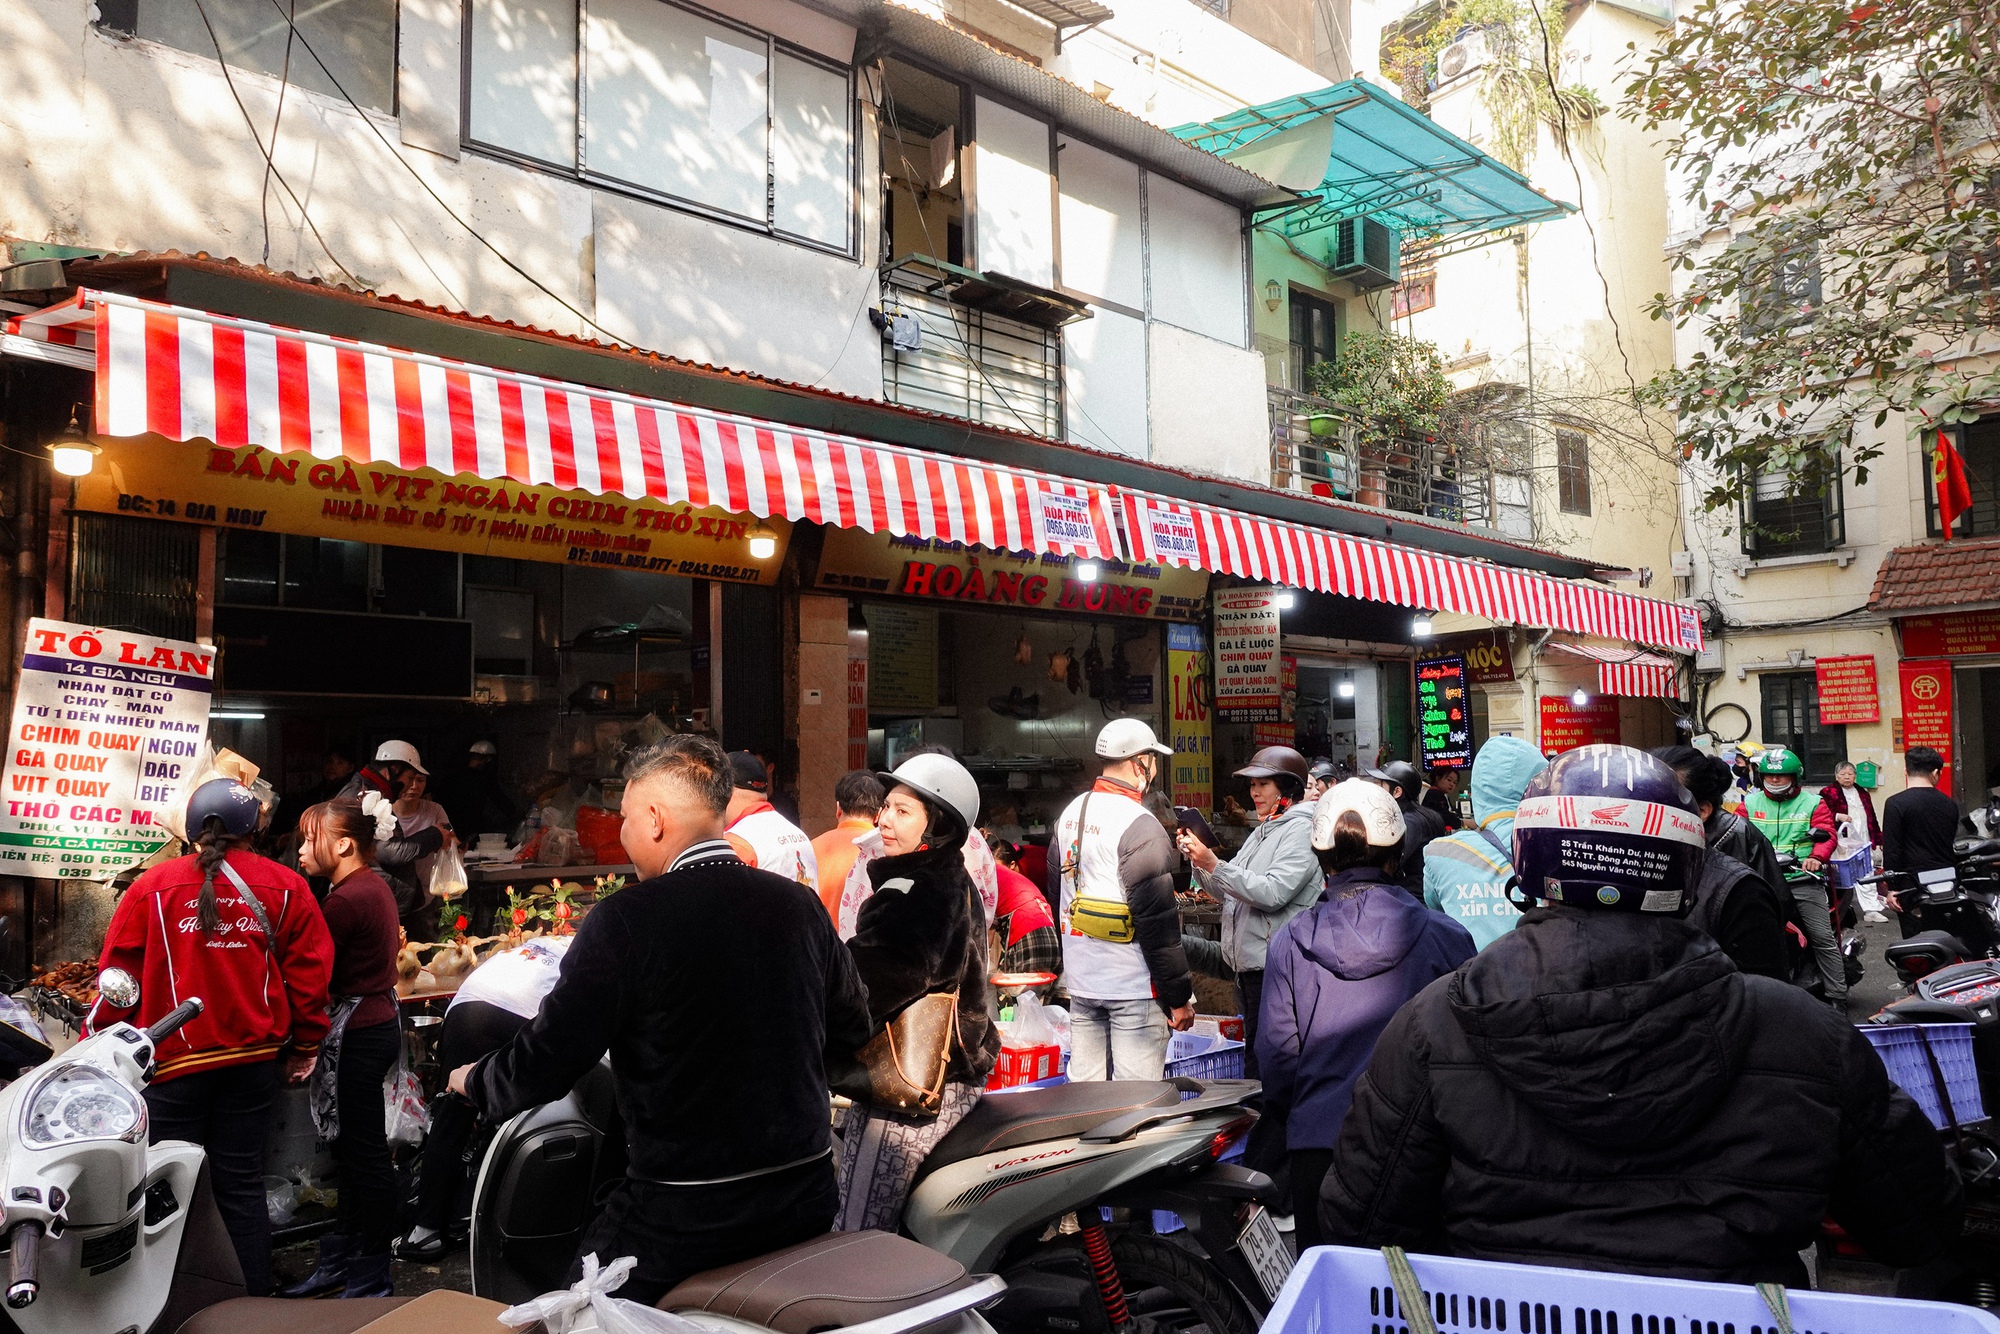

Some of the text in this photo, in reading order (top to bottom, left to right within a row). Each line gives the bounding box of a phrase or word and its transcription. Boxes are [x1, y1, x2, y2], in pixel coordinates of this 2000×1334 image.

[208, 447, 749, 542] BÁN GÀ VỊT NGAN CHIM THỎ XỊN
[156, 498, 175, 516] 14
[185, 502, 216, 522] GIA
[1046, 518, 1094, 540] 0966.868.491
[903, 556, 1153, 616] HOÀNG DUNG
[1217, 592, 1227, 600] GÀ
[1228, 590, 1253, 600] HOÀNG
[1217, 612, 1248, 622] NHẬN
[1945, 625, 1977, 635] QUẢN LÝ
[1219, 639, 1232, 650] GÀ
[1249, 638, 1274, 650] LUỘC
[1946, 634, 1967, 645] QUẢN
[1969, 634, 1978, 643] LÝ
[35, 629, 211, 676] TỐ LAN
[1220, 652, 1273, 663] CHIM QUAY
[1466, 641, 1503, 674] MỘC
[1947, 645, 1987, 655] ĐỊA CHÍNH
[65, 661, 177, 686] 14 GIA NGƯ
[1227, 663, 1267, 674] GÀ QUAY
[57, 679, 105, 695] NHẬN
[112, 685, 146, 701] ĐẶT
[1218, 675, 1277, 688] VỊT QUAY LẠNG SƠN
[1420, 680, 1435, 693] Gà
[1219, 687, 1233, 695] XÔI
[1234, 686, 1250, 695] CÁC
[63, 694, 109, 709] CHAY
[1558, 702, 1570, 713] GÀ
[26, 705, 200, 734] TỪ 1 ĐẾN NHIỀU MÂM
[1231, 715, 1248, 723] 0912
[1249, 708, 1268, 716] 5555
[20, 724, 141, 752] CHIM QUAY
[1200, 735, 1211, 757] VỊT
[148, 737, 197, 757] NGON
[16, 748, 109, 774] GÀ QUAY
[144, 761, 181, 782] ĐẶC
[12, 774, 110, 799] VỊT QUAY
[8, 799, 59, 819] THỎ
[70, 804, 122, 824] CÁC
[1590, 818, 1630, 828] HONDA
[73, 825, 94, 836] VỤ
[103, 827, 129, 839] TẠI
[134, 829, 167, 839] NHÀ
[32, 836, 152, 852] GIÁ CẢ HỢP LÝ
[1561, 839, 1671, 862] 25 Trần Khánh Dư, Hà Nội
[31, 851, 54, 864] HỆ:
[60, 853, 95, 864] 090
[101, 855, 133, 866] 685
[1561, 849, 1572, 857] Tổ
[1598, 854, 1621, 866] Đông
[1622, 859, 1642, 869] Anh,
[1655, 864, 1668, 872] Nội
[58, 867, 92, 878] 039
[1561, 859, 1665, 881] 545 Nguyễn Văn Cừ, Hà Nội
[1460, 900, 1488, 917] xin
[994, 1147, 1077, 1171] VISION
